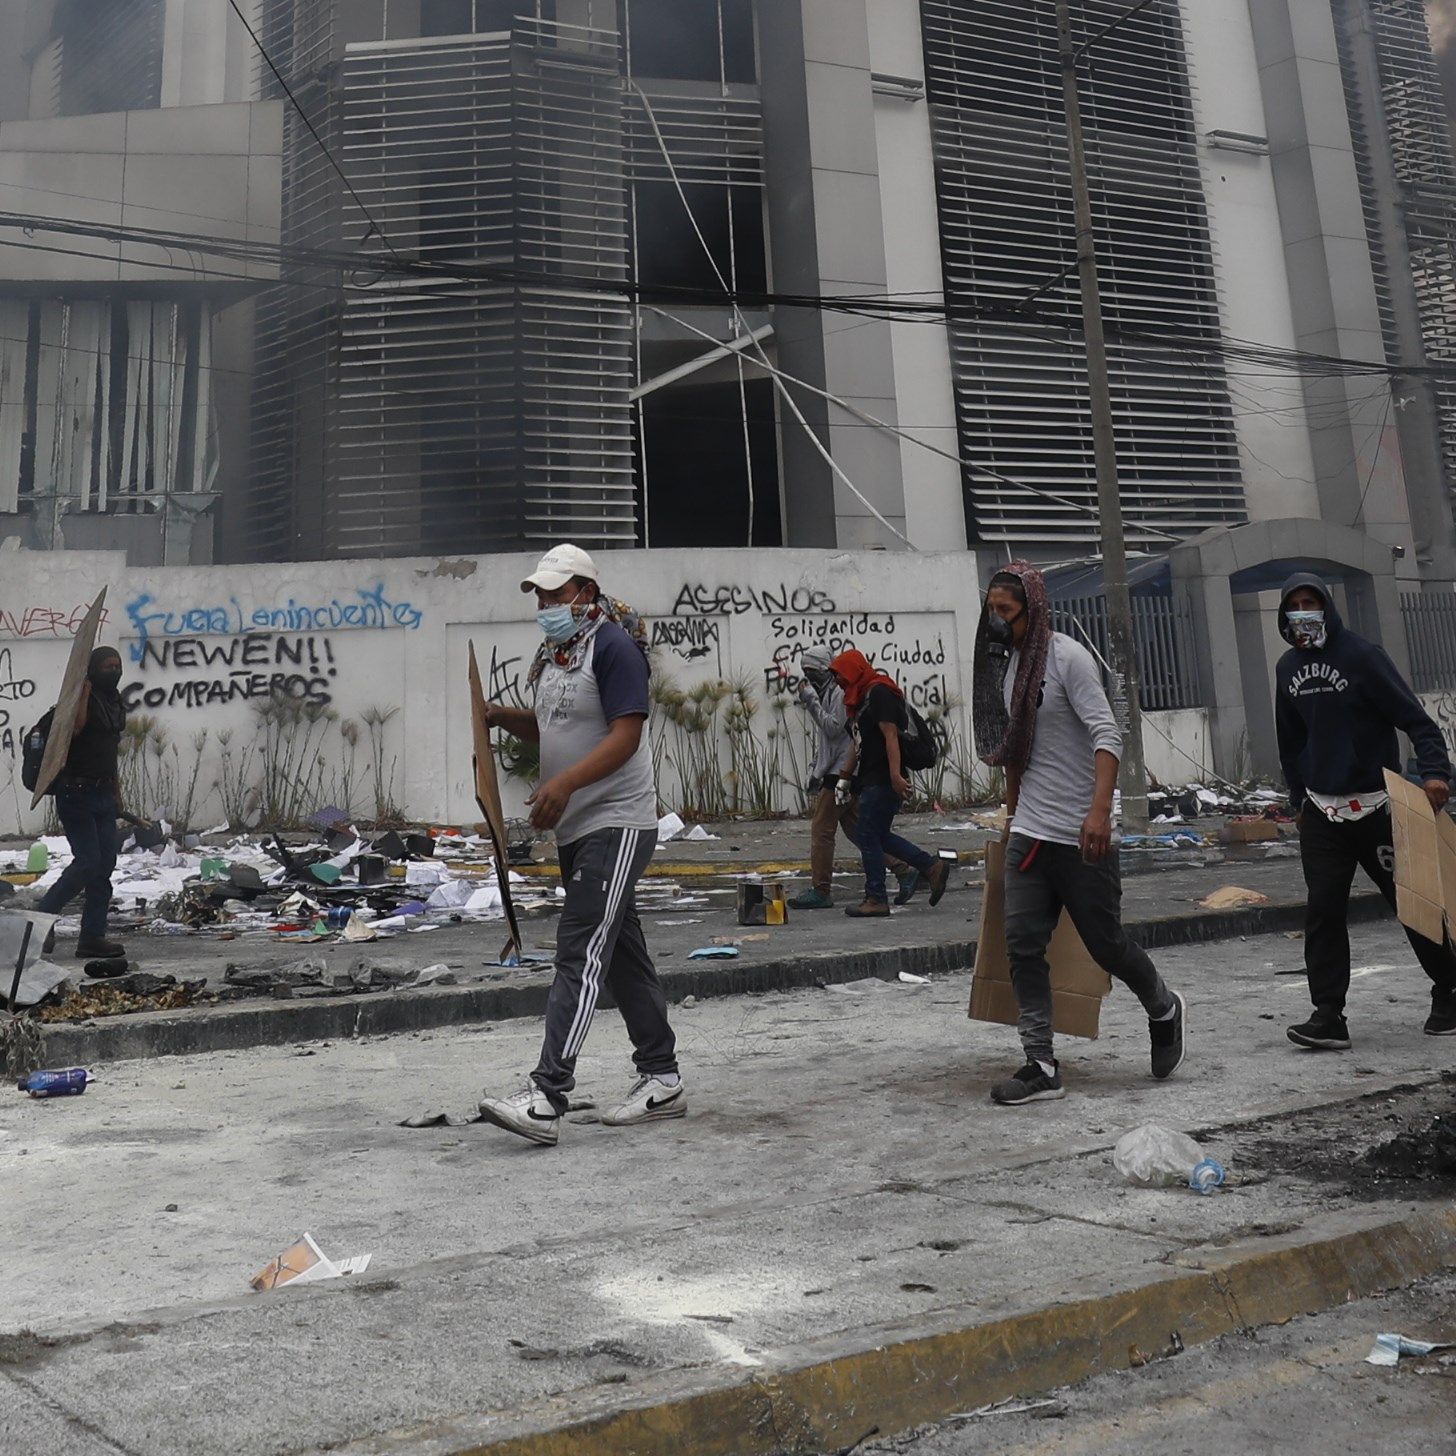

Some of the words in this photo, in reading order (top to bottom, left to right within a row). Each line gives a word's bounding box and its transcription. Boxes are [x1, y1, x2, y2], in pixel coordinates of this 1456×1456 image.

[672, 583, 836, 615] ASESINOS
[772, 637, 856, 663] CAPO
[881, 638, 945, 665] Ciudad
[1288, 662, 1348, 697] SALZBURG
